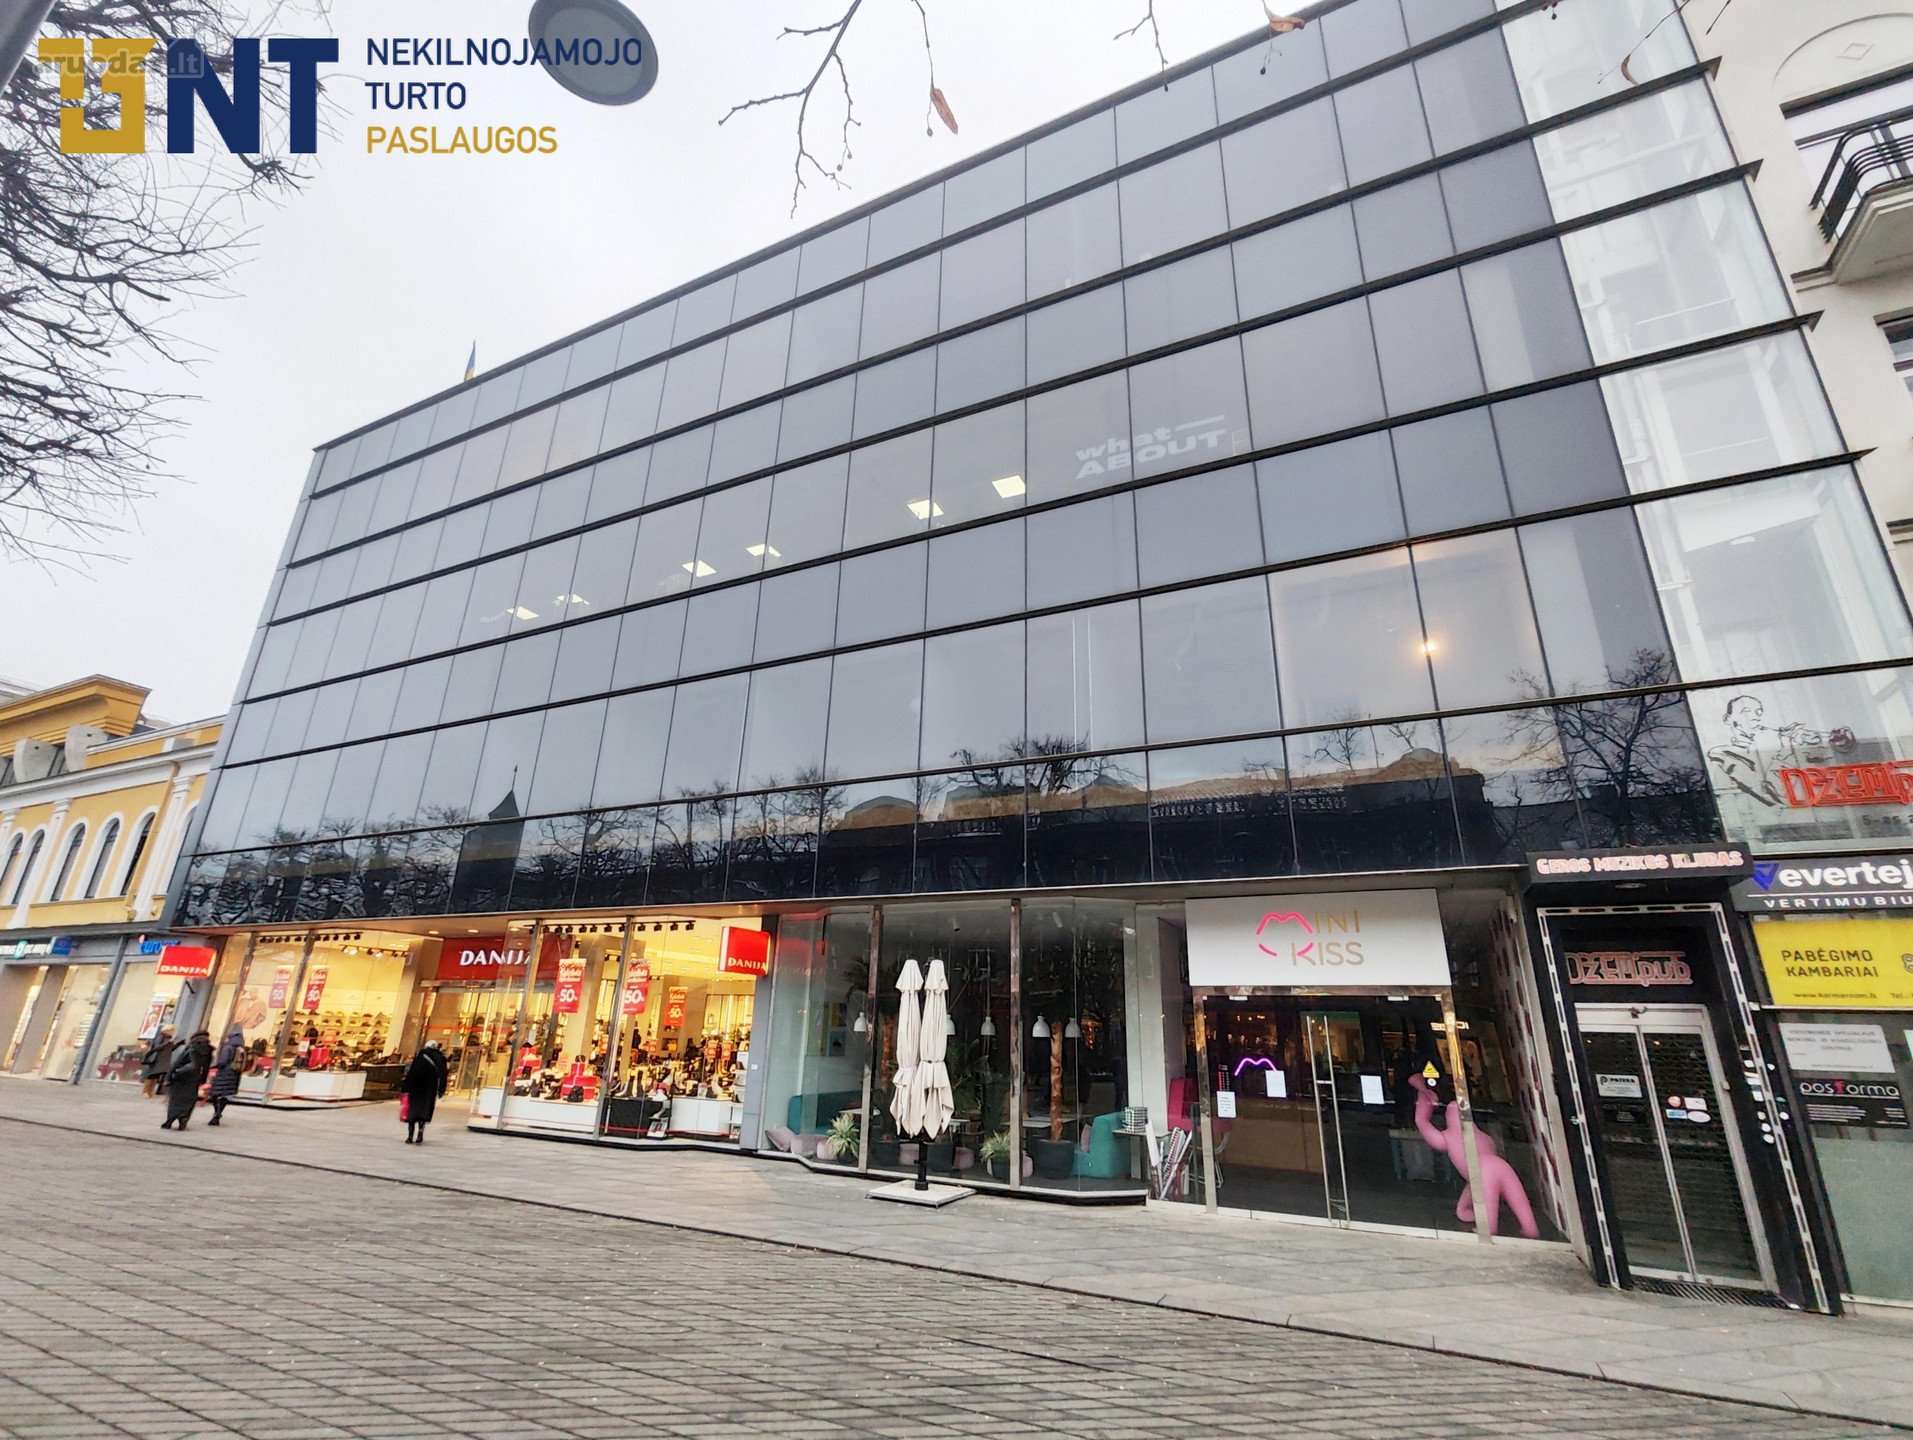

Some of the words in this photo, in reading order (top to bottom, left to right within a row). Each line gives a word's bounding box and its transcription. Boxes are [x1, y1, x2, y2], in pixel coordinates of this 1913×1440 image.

[1075, 426, 1172, 461] what
[1075, 428, 1227, 480] ABOUT
[1593, 853, 1670, 872] MUZIKOS
[1291, 941, 1365, 966] KISS
[1781, 948, 1874, 962] PABĖGIMO
[728, 956, 767, 971] DANIJA
[1786, 966, 1879, 977] KAMBARIAI
